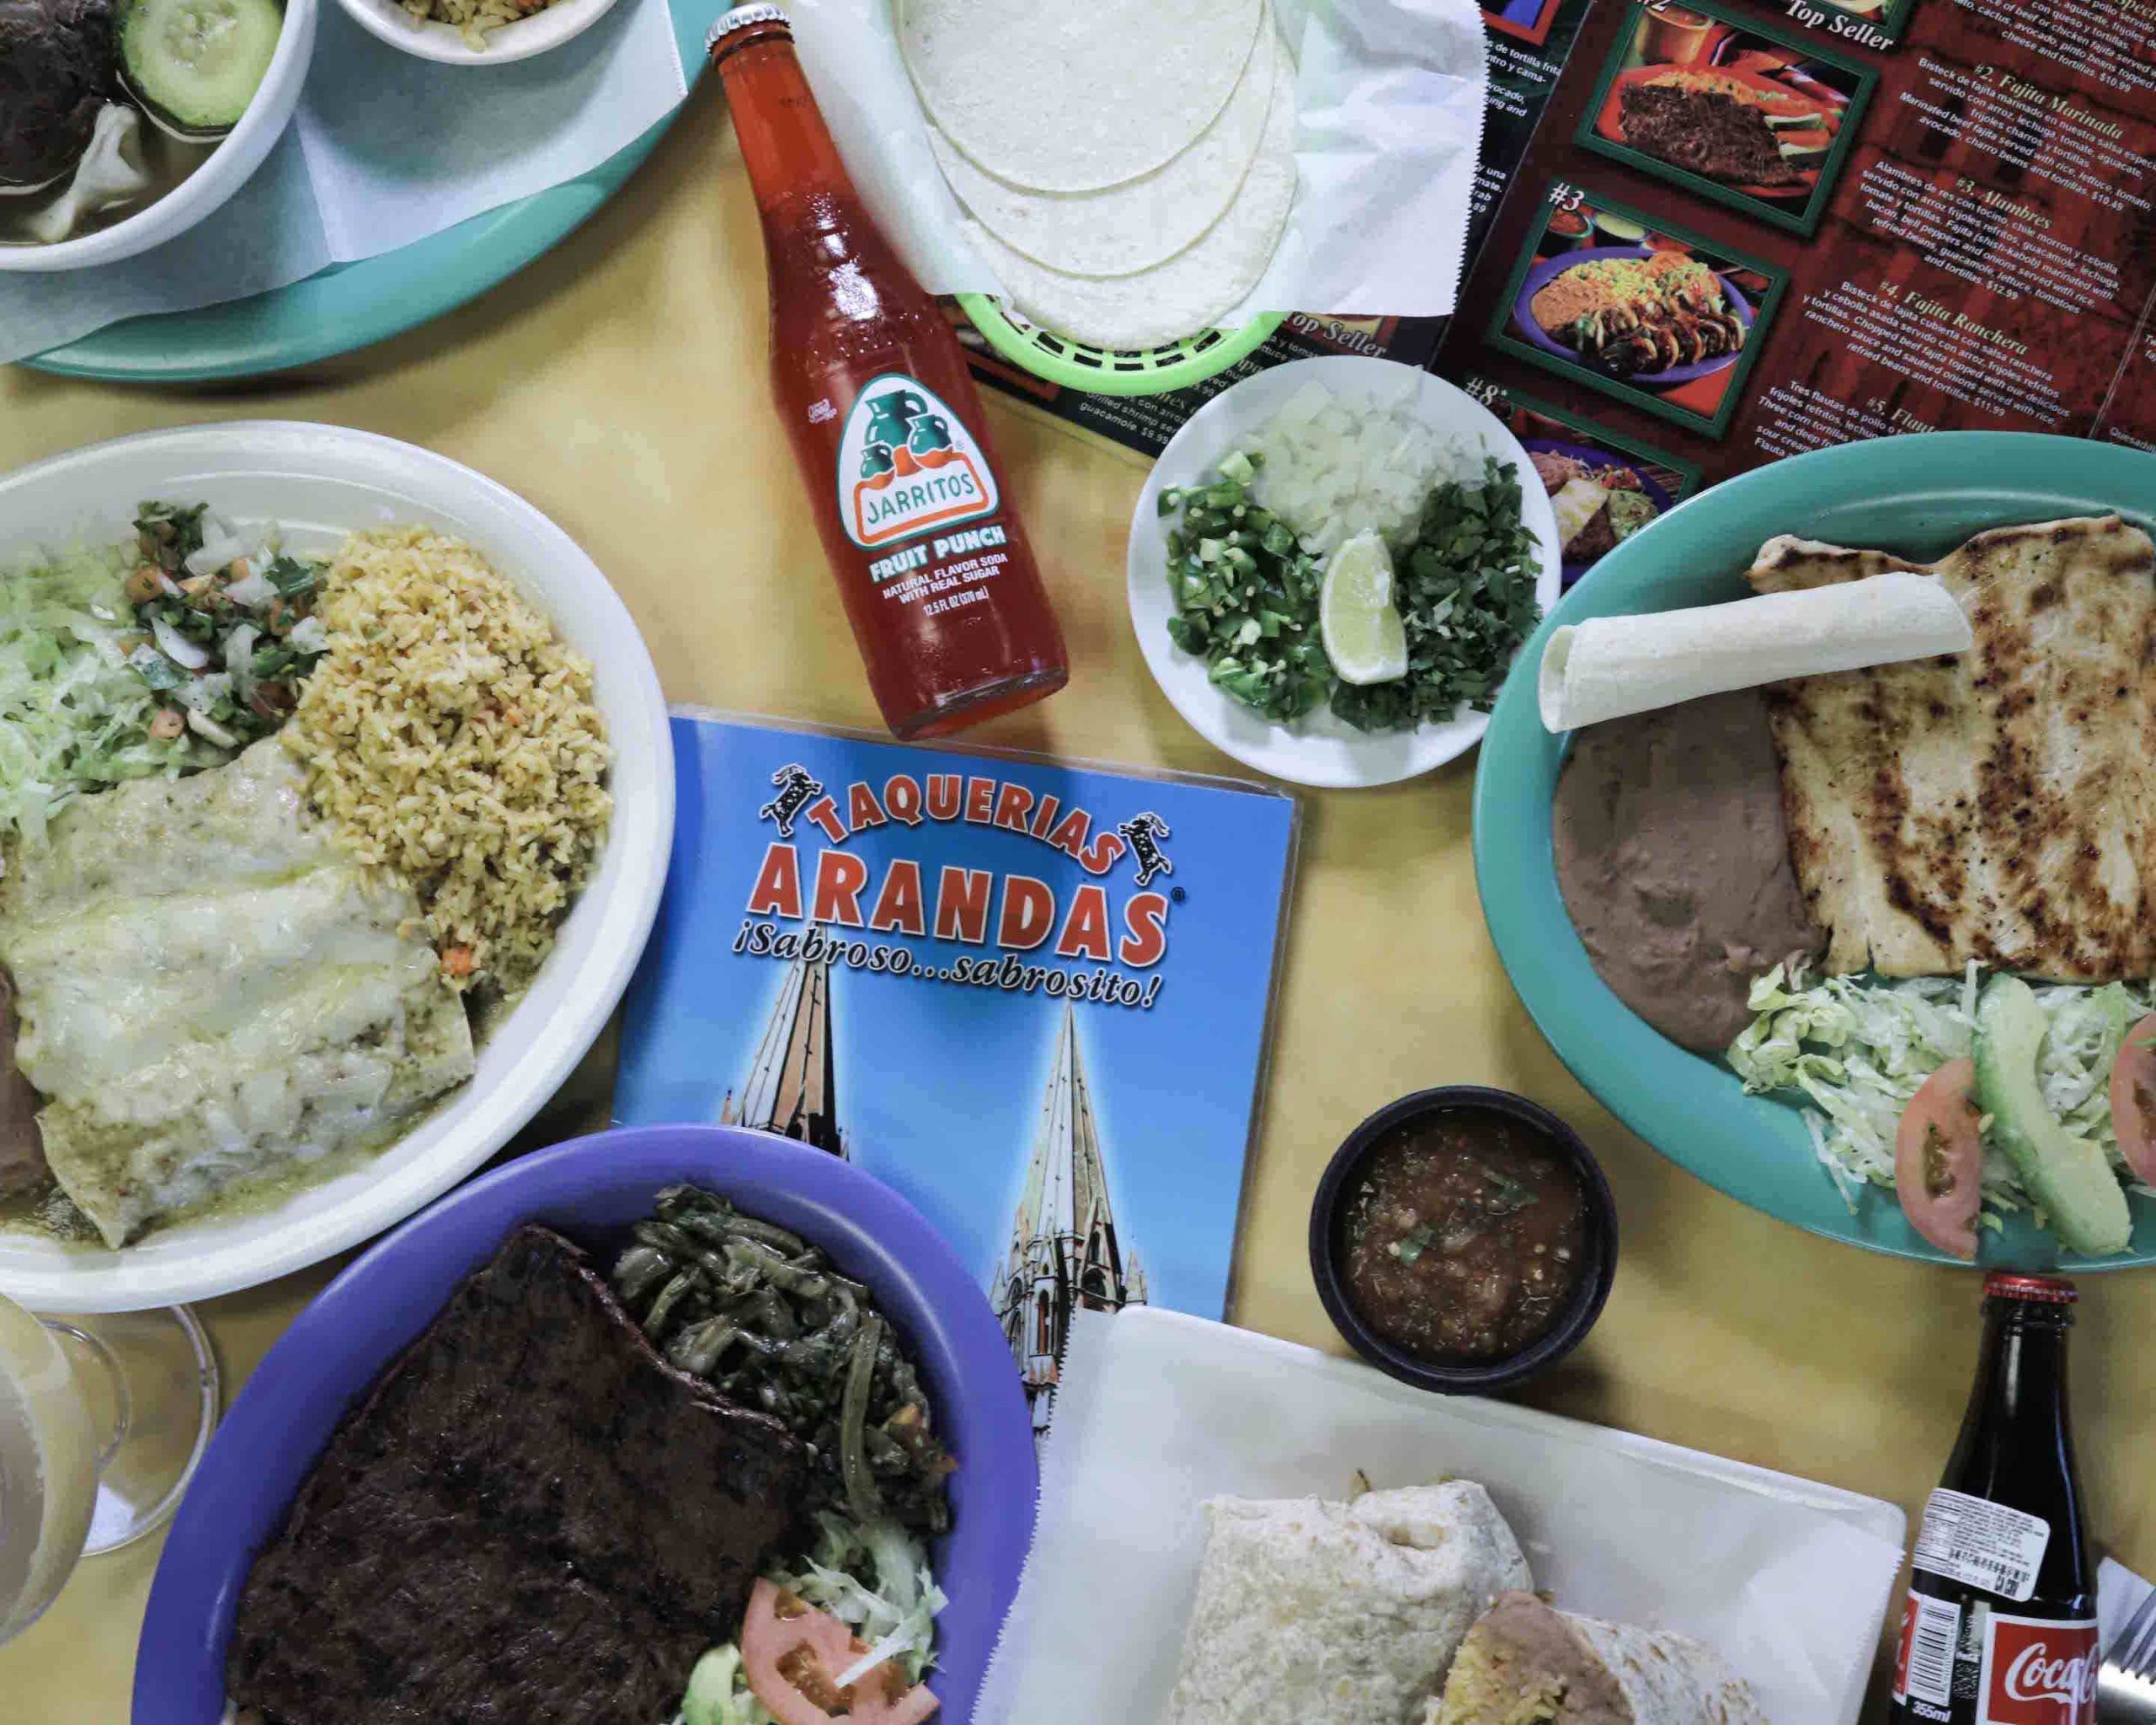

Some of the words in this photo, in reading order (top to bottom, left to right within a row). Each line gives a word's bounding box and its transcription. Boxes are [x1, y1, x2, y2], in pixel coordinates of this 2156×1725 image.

[1785, 0, 1826, 29] Top
[1826, 14, 1895, 51] Seller
[1509, 47, 1542, 69] tortilla
[1487, 83, 1528, 106] vocado,
[1506, 104, 1528, 118] and
[1973, 62, 1993, 82] #2.
[1998, 74, 2046, 107] Fajita
[2048, 96, 2123, 138] Marinada
[1486, 167, 1508, 180] una
[1548, 182, 1585, 211] #3
[1955, 177, 1975, 196] #3.
[1978, 190, 2052, 228] Alambres
[1286, 312, 1321, 336] op
[1322, 320, 1388, 358] Seller
[1878, 280, 1900, 298] #4.
[1903, 291, 1951, 321] Fajita
[1952, 312, 2028, 354] Ranchera
[1865, 396, 1886, 414] #5.
[867, 473, 975, 524] JARRITOS
[869, 545, 928, 583] FRUIT
[933, 526, 1006, 560] PUNCH
[883, 574, 933, 600] NATURAL
[933, 558, 979, 579] FLAVOR
[979, 553, 1009, 568] SODA
[898, 585, 930, 604] WITH
[930, 576, 962, 593] REAL
[962, 565, 1001, 583] SUGAR
[807, 773, 1127, 876] TAQUERIAS
[746, 841, 1169, 968] ARANDAS
[1911, 1702, 1951, 1723] 355ml
